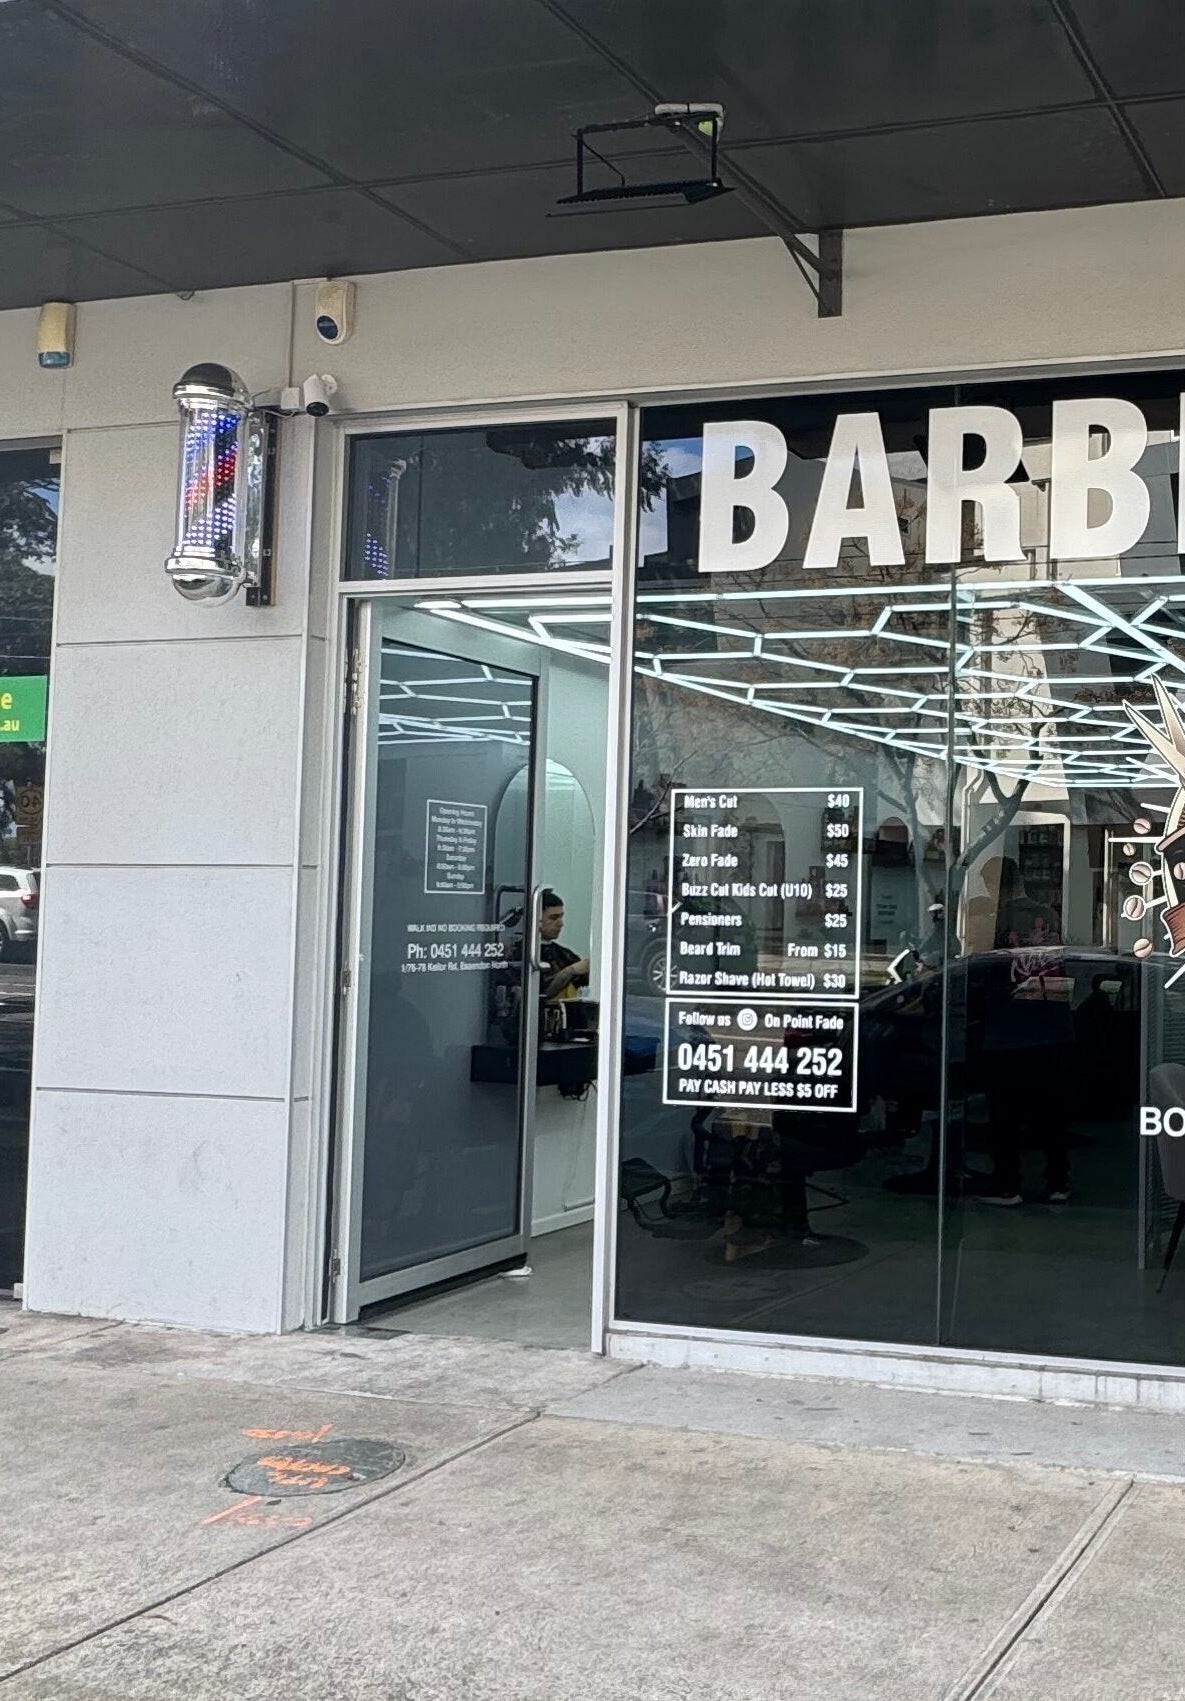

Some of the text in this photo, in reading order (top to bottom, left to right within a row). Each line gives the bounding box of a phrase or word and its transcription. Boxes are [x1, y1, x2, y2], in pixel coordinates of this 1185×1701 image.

[684, 794, 850, 808] Men's Cut $40
[683, 823, 849, 838] Skin Fade $50
[682, 853, 848, 868] Zero Fade $45
[682, 883, 848, 899] Buzz Cut Kids Cut (U10) $25
[680, 912, 847, 928] Pensioners $25
[407, 942, 504, 959] Ph: 0451 444 252
[680, 941, 846, 958] Beard Trim From $15
[679, 971, 846, 990] Razor Shave (Hot Towel) $30
[678, 1011, 843, 1030] Follow us On Point Fade
[677, 1043, 843, 1076] 0451 444 252
[678, 1078, 838, 1099] PAY CASH PAY LESS $5 OFF
